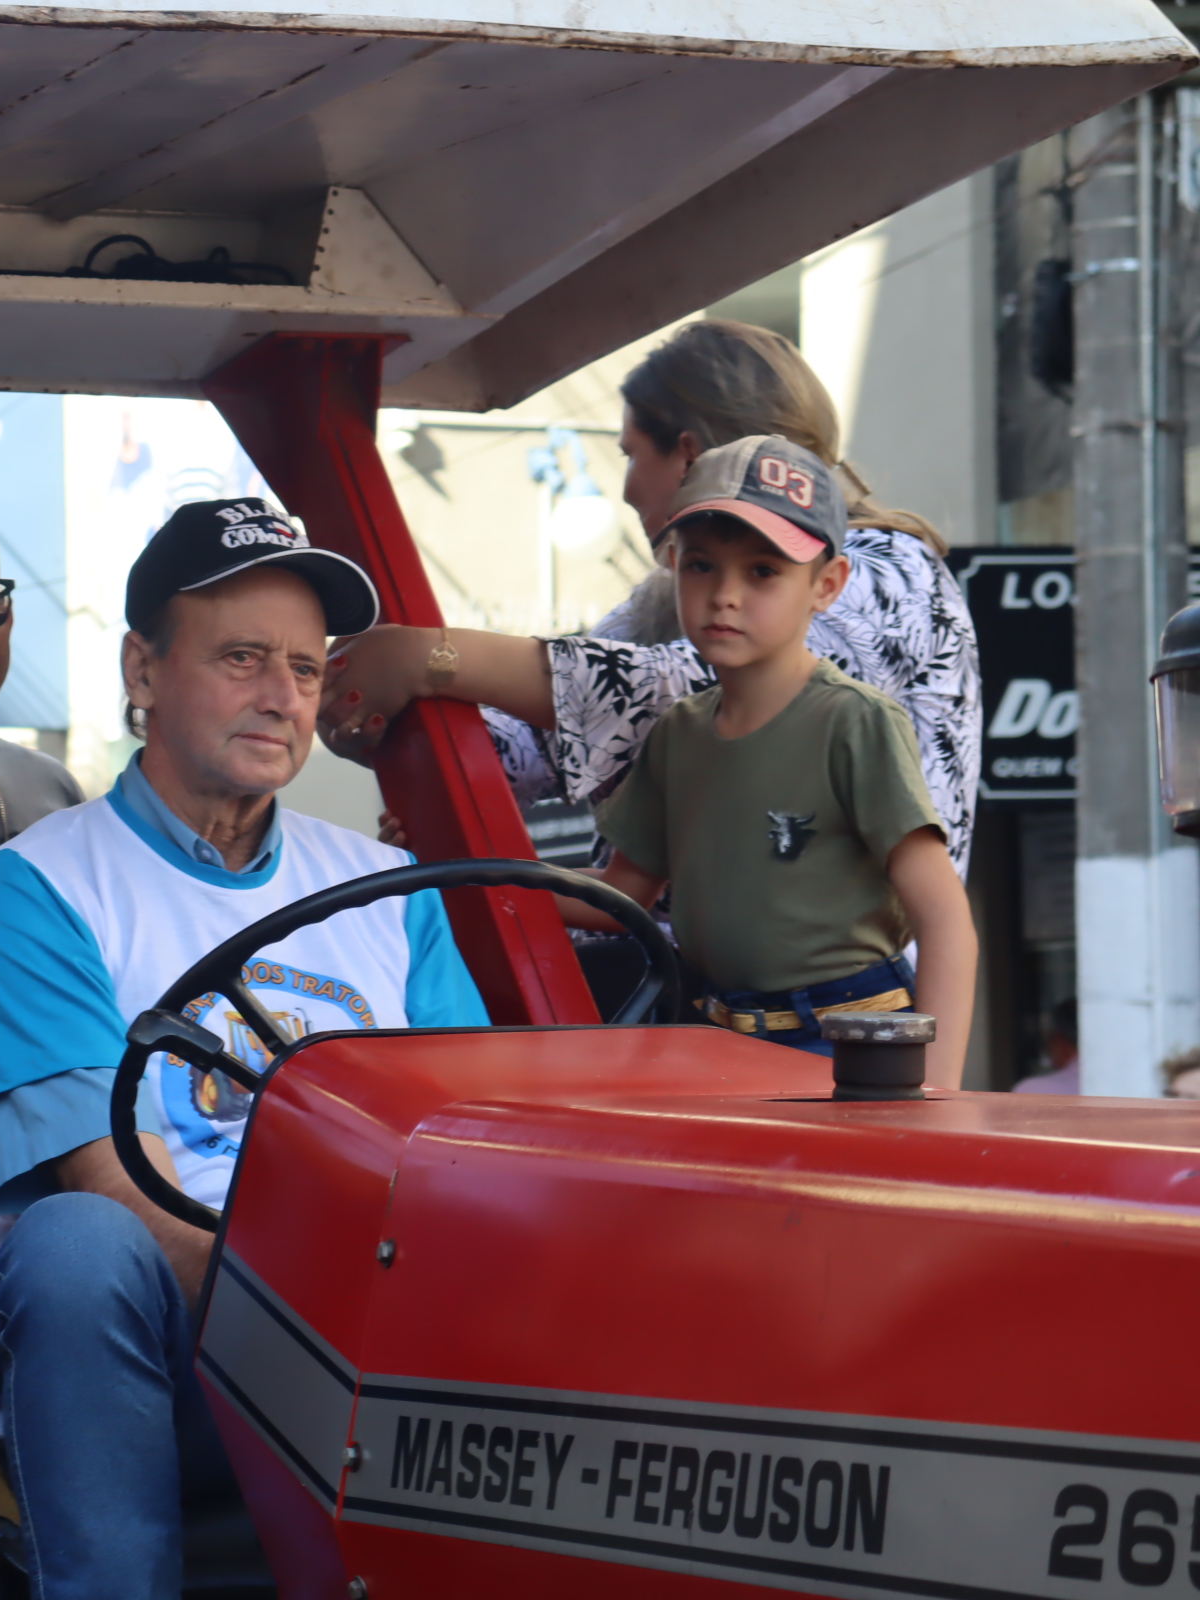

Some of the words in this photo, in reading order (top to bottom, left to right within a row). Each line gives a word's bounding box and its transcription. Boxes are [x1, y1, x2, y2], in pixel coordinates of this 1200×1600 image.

[759, 456, 815, 510] 03
[1001, 571, 1079, 609] LO
[988, 679, 1080, 738] Do
[290, 969, 376, 1029] TRATOR
[1048, 1483, 1200, 1592] 26
